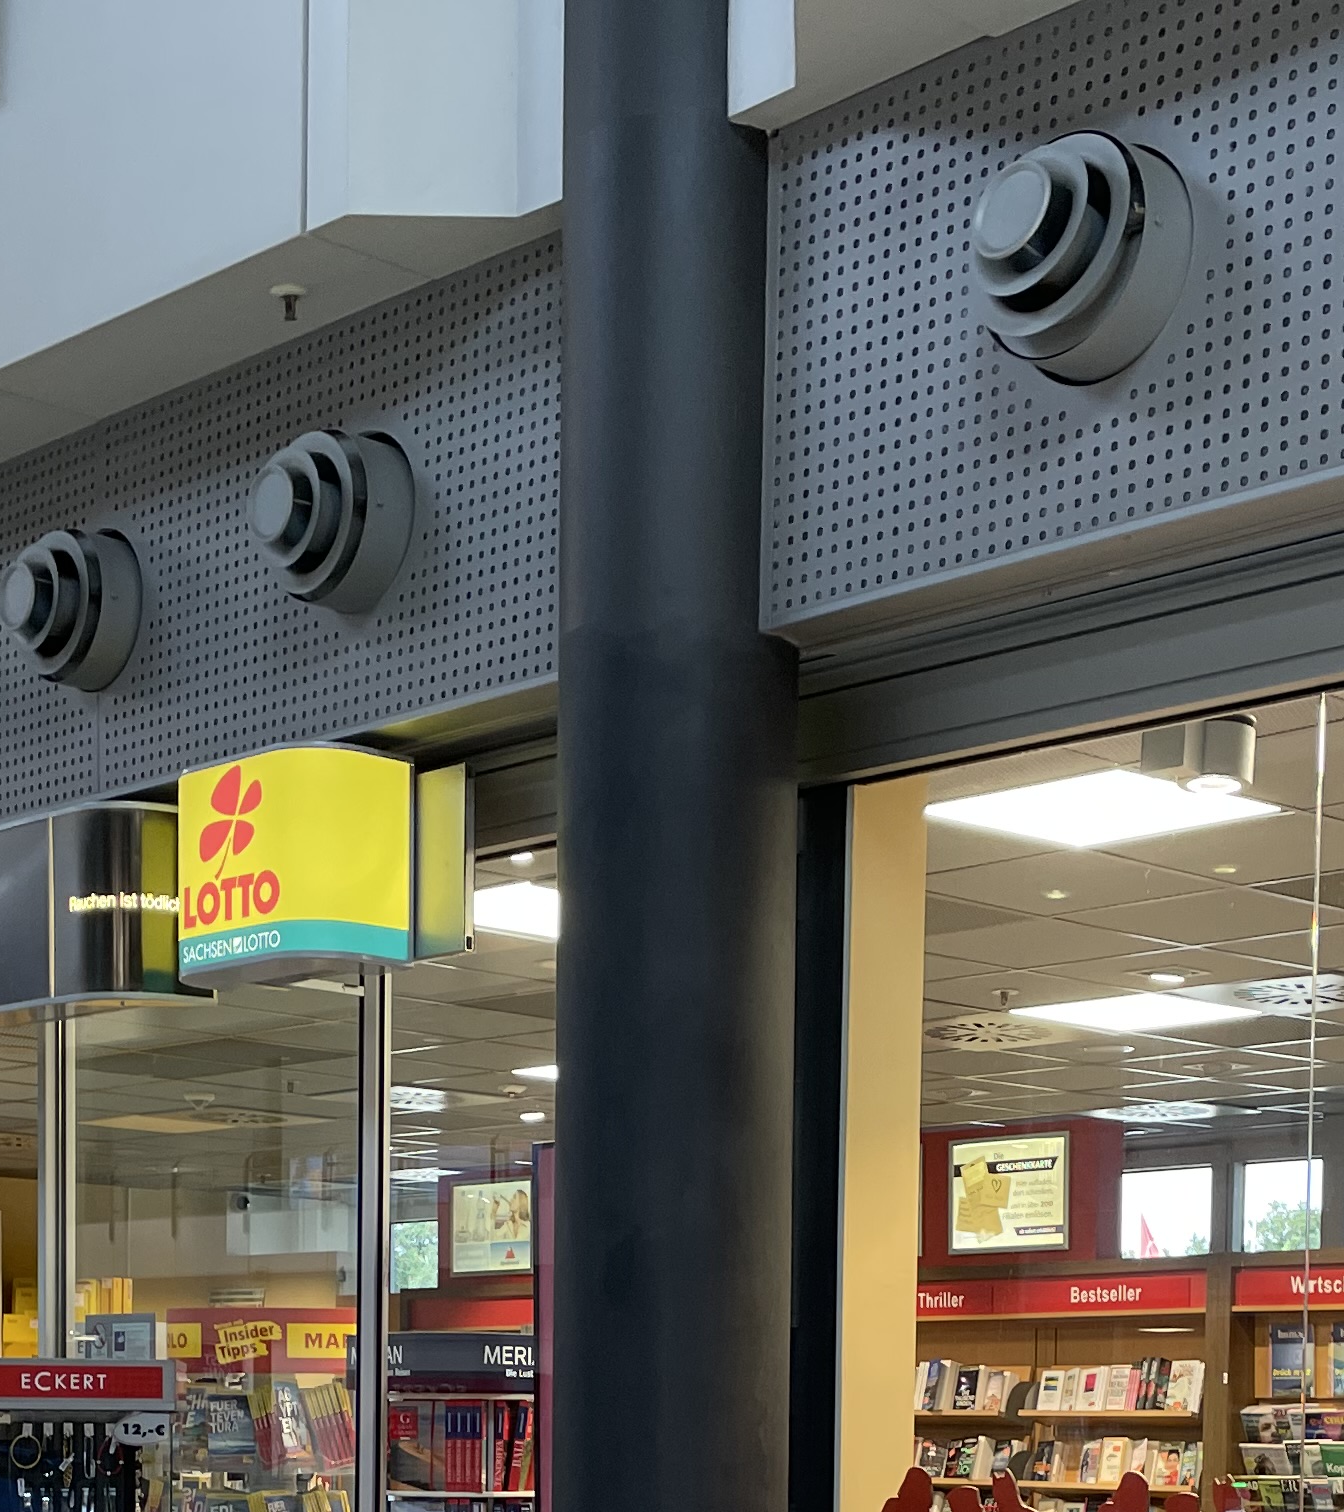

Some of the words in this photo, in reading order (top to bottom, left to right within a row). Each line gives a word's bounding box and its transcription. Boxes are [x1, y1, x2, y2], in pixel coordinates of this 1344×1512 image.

[68, 893, 116, 912] Rauchen
[119, 891, 138, 909] ist
[184, 870, 280, 930] LOTTO
[996, 1159, 1053, 1172] GESCHENKKARTE
[917, 1292, 965, 1309] Thriller
[1070, 1285, 1142, 1304] Bestseller
[224, 1324, 275, 1343] Insider
[219, 1341, 258, 1359] Tipps
[483, 1345, 535, 1366] MERI
[21, 1371, 107, 1392] ECKERT
[122, 1422, 166, 1437] 12,-€
